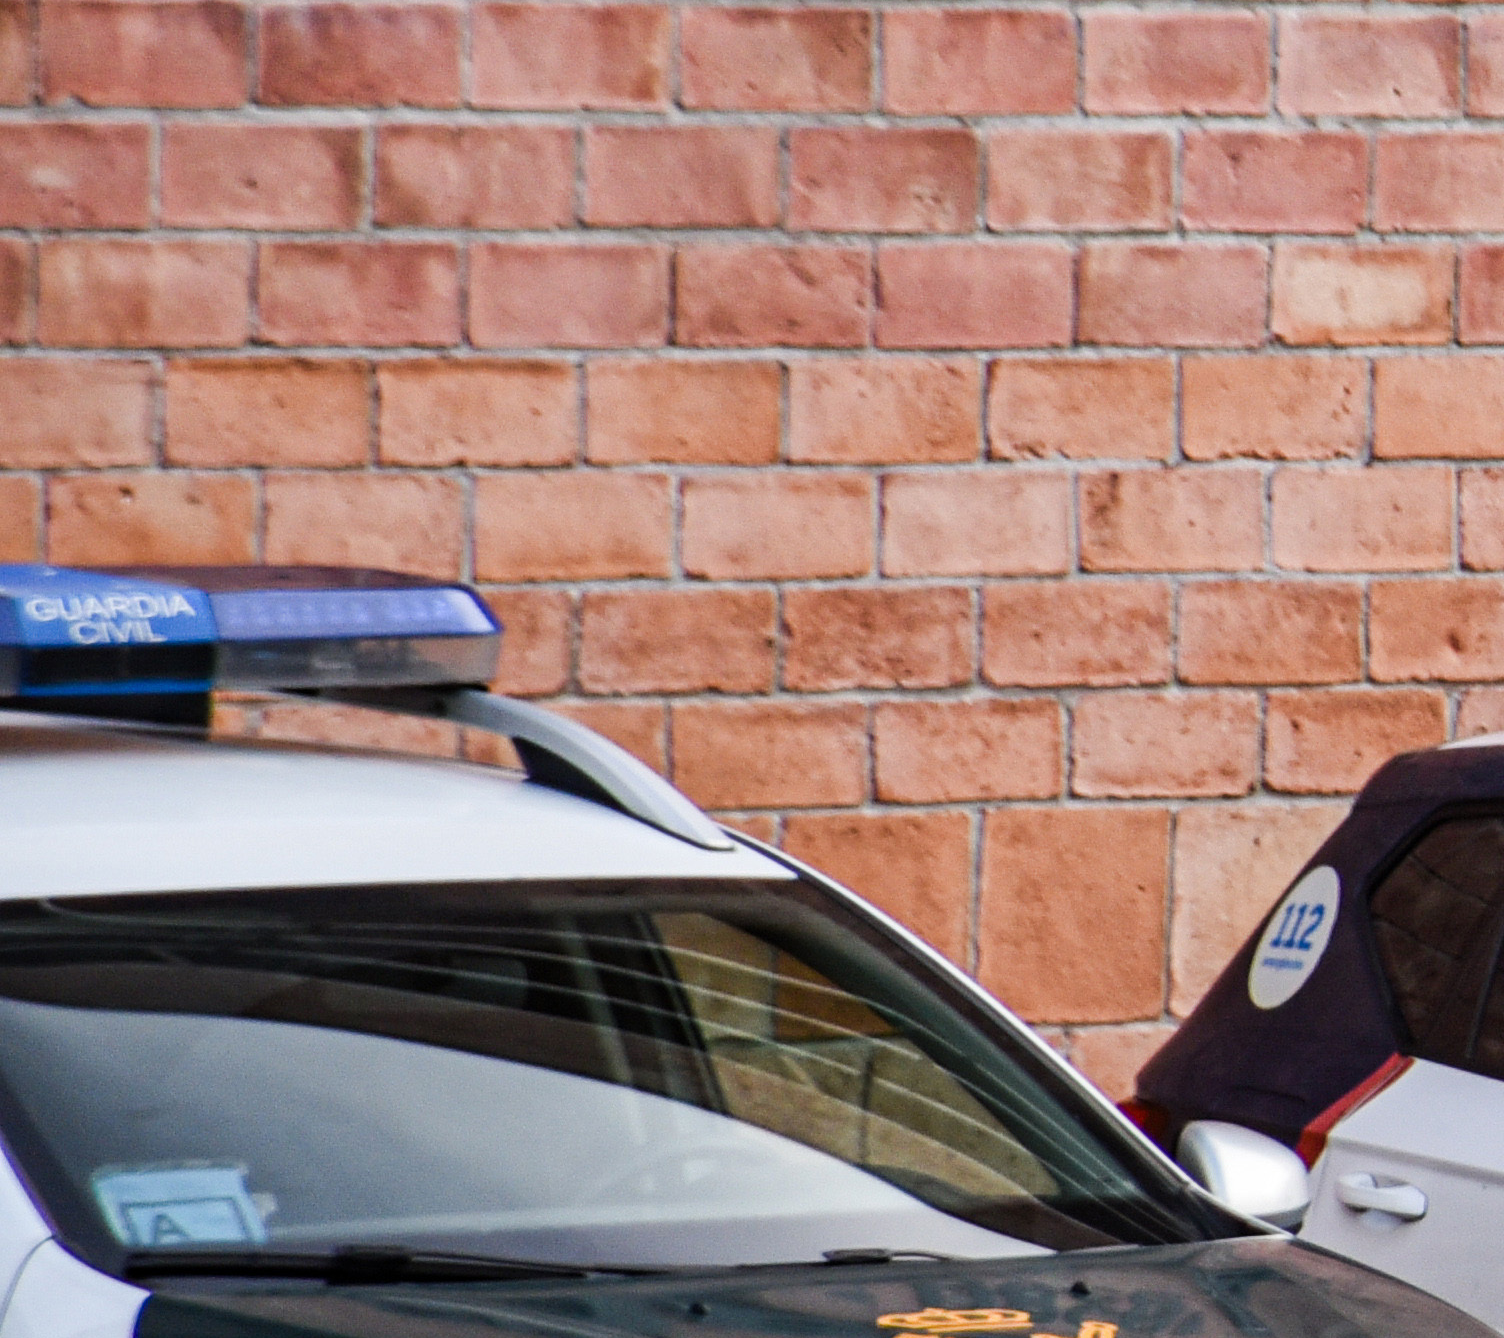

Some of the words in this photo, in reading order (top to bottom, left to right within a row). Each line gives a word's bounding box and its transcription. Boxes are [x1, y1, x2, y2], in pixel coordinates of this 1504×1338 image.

[25, 592, 197, 622] GUARDIA
[68, 619, 168, 645] CIVIL
[1270, 903, 1326, 951] 112
